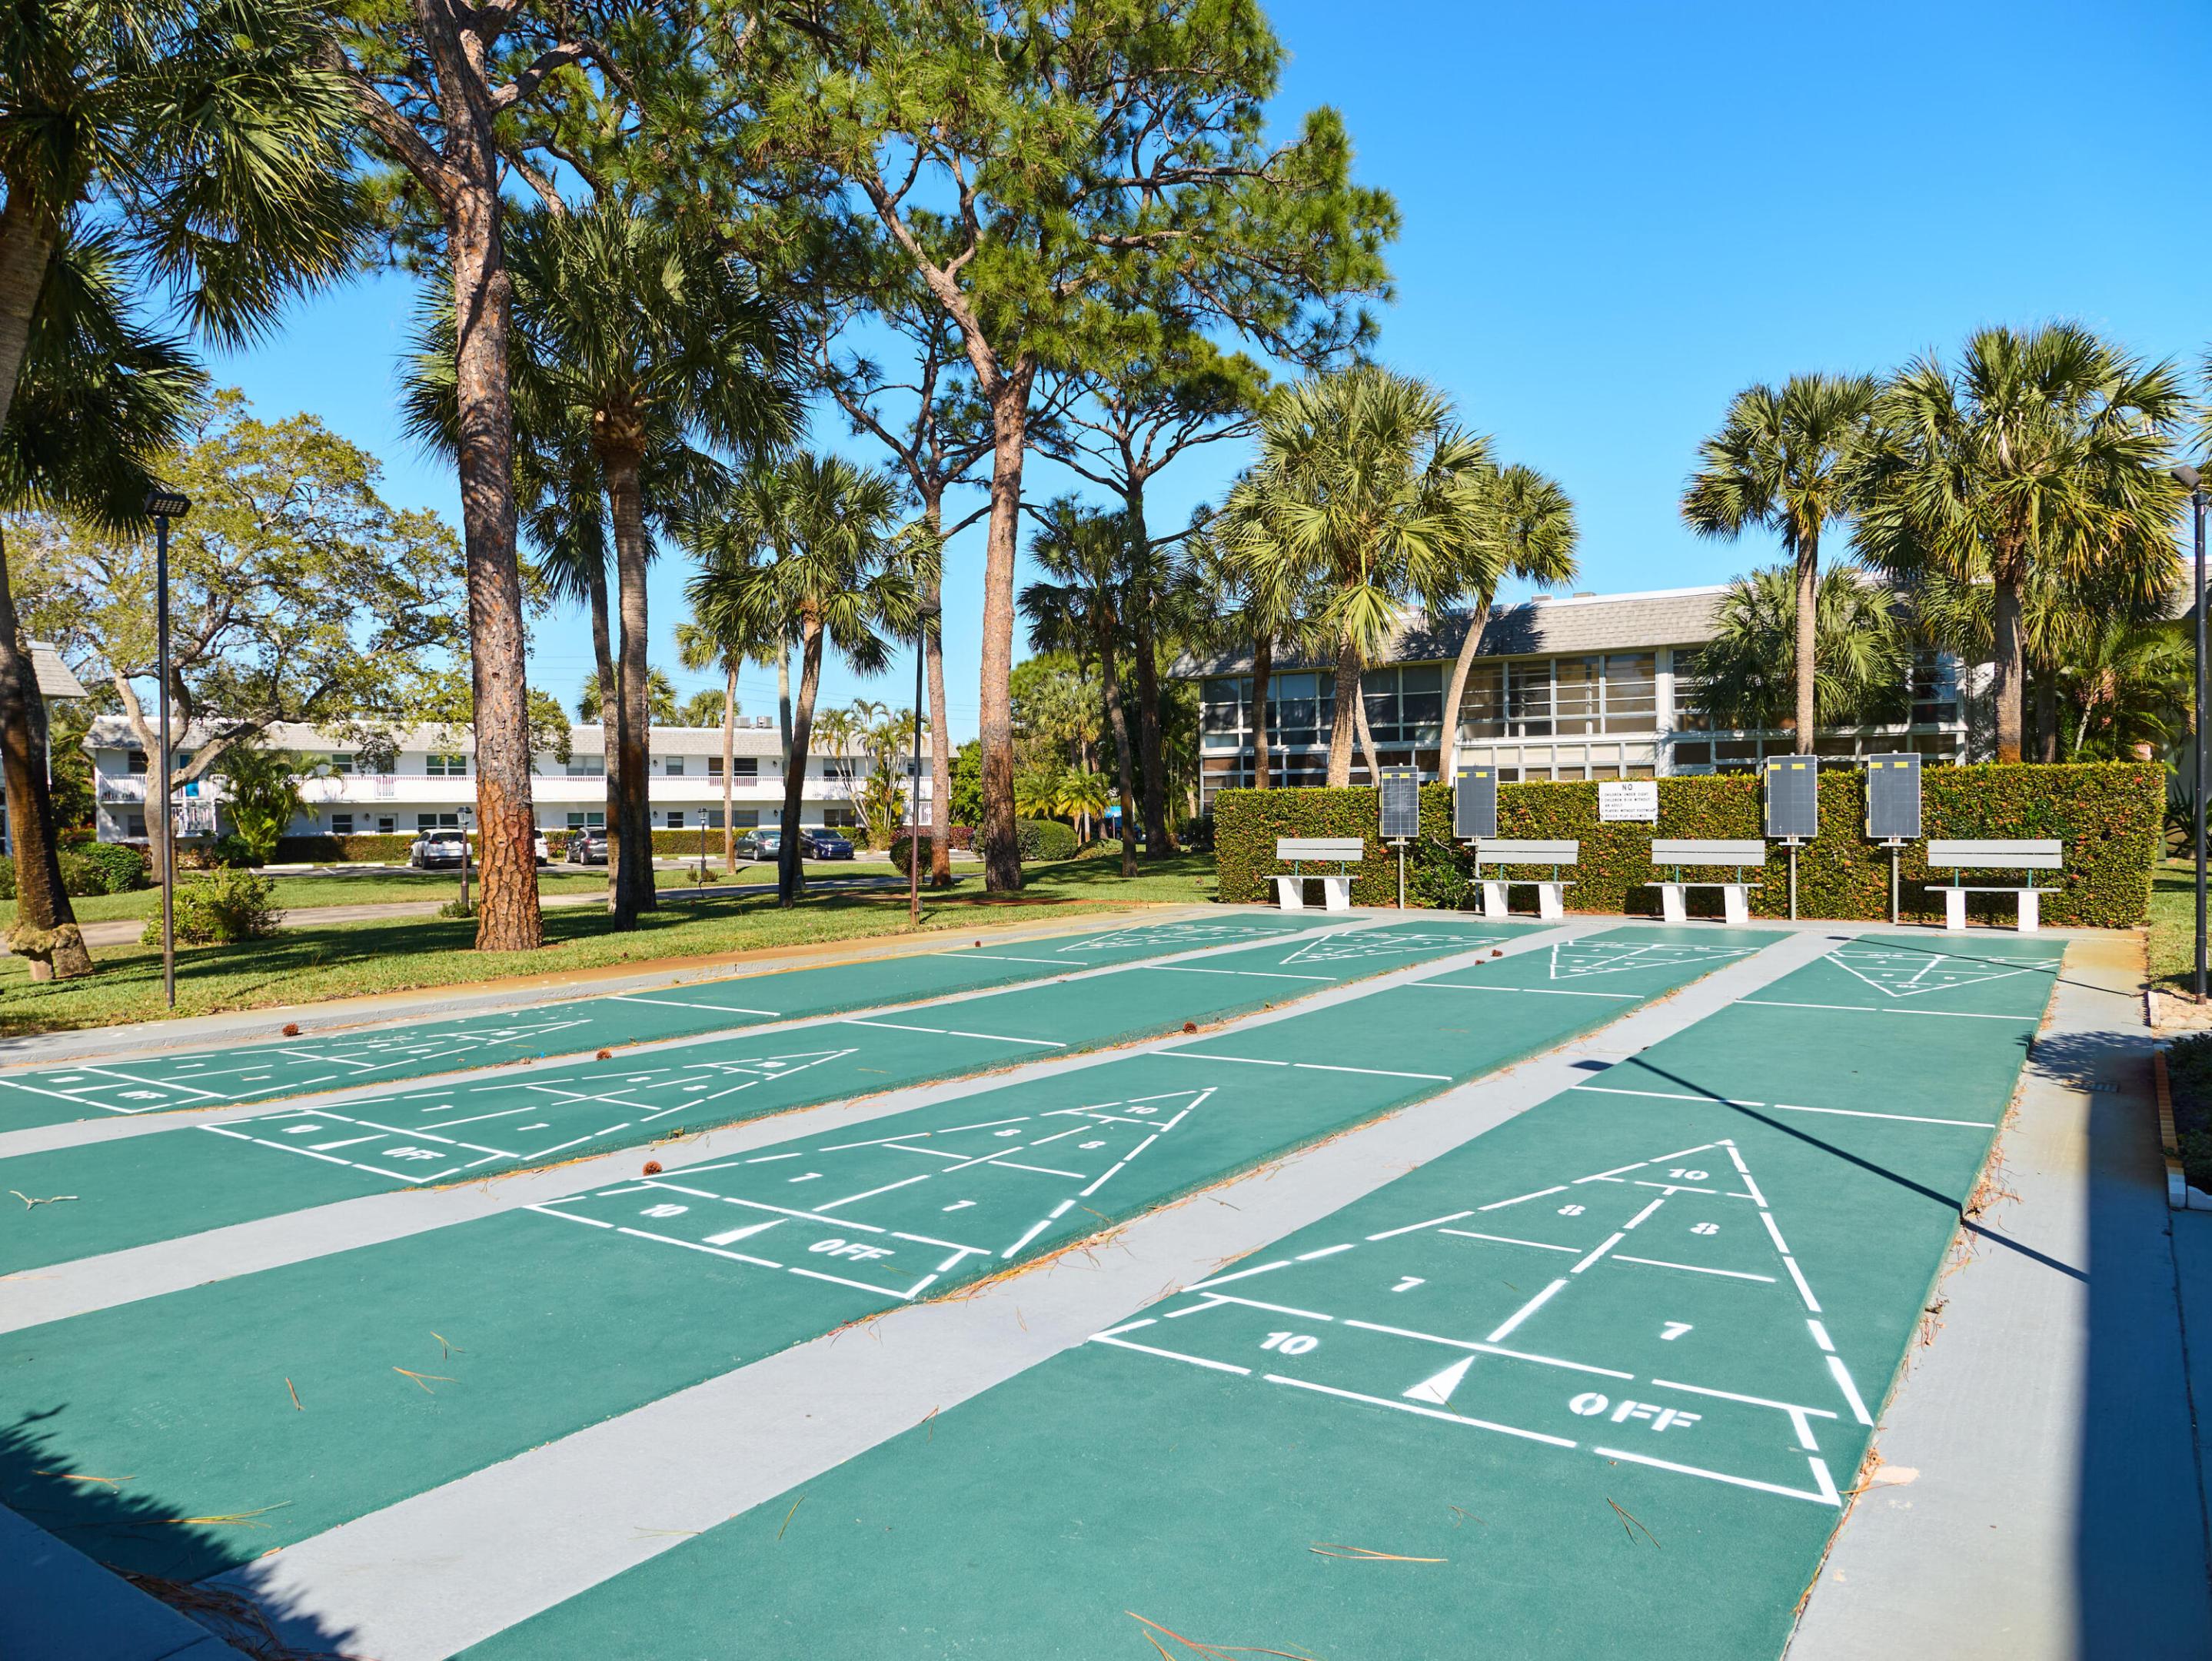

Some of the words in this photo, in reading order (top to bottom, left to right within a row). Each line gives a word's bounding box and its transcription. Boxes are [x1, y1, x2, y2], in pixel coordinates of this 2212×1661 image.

[382, 1147, 446, 1160] OFF
[1669, 1169, 1709, 1180] 10
[1558, 1205, 1585, 1216] 8
[640, 1204, 689, 1217] 10
[808, 1239, 895, 1260] OFF
[1690, 1223, 1719, 1235] 8
[1391, 1276, 1425, 1292] 7
[1660, 1321, 1693, 1340] 7
[1260, 1332, 1319, 1355] 10
[1568, 1393, 1701, 1431] OFF
